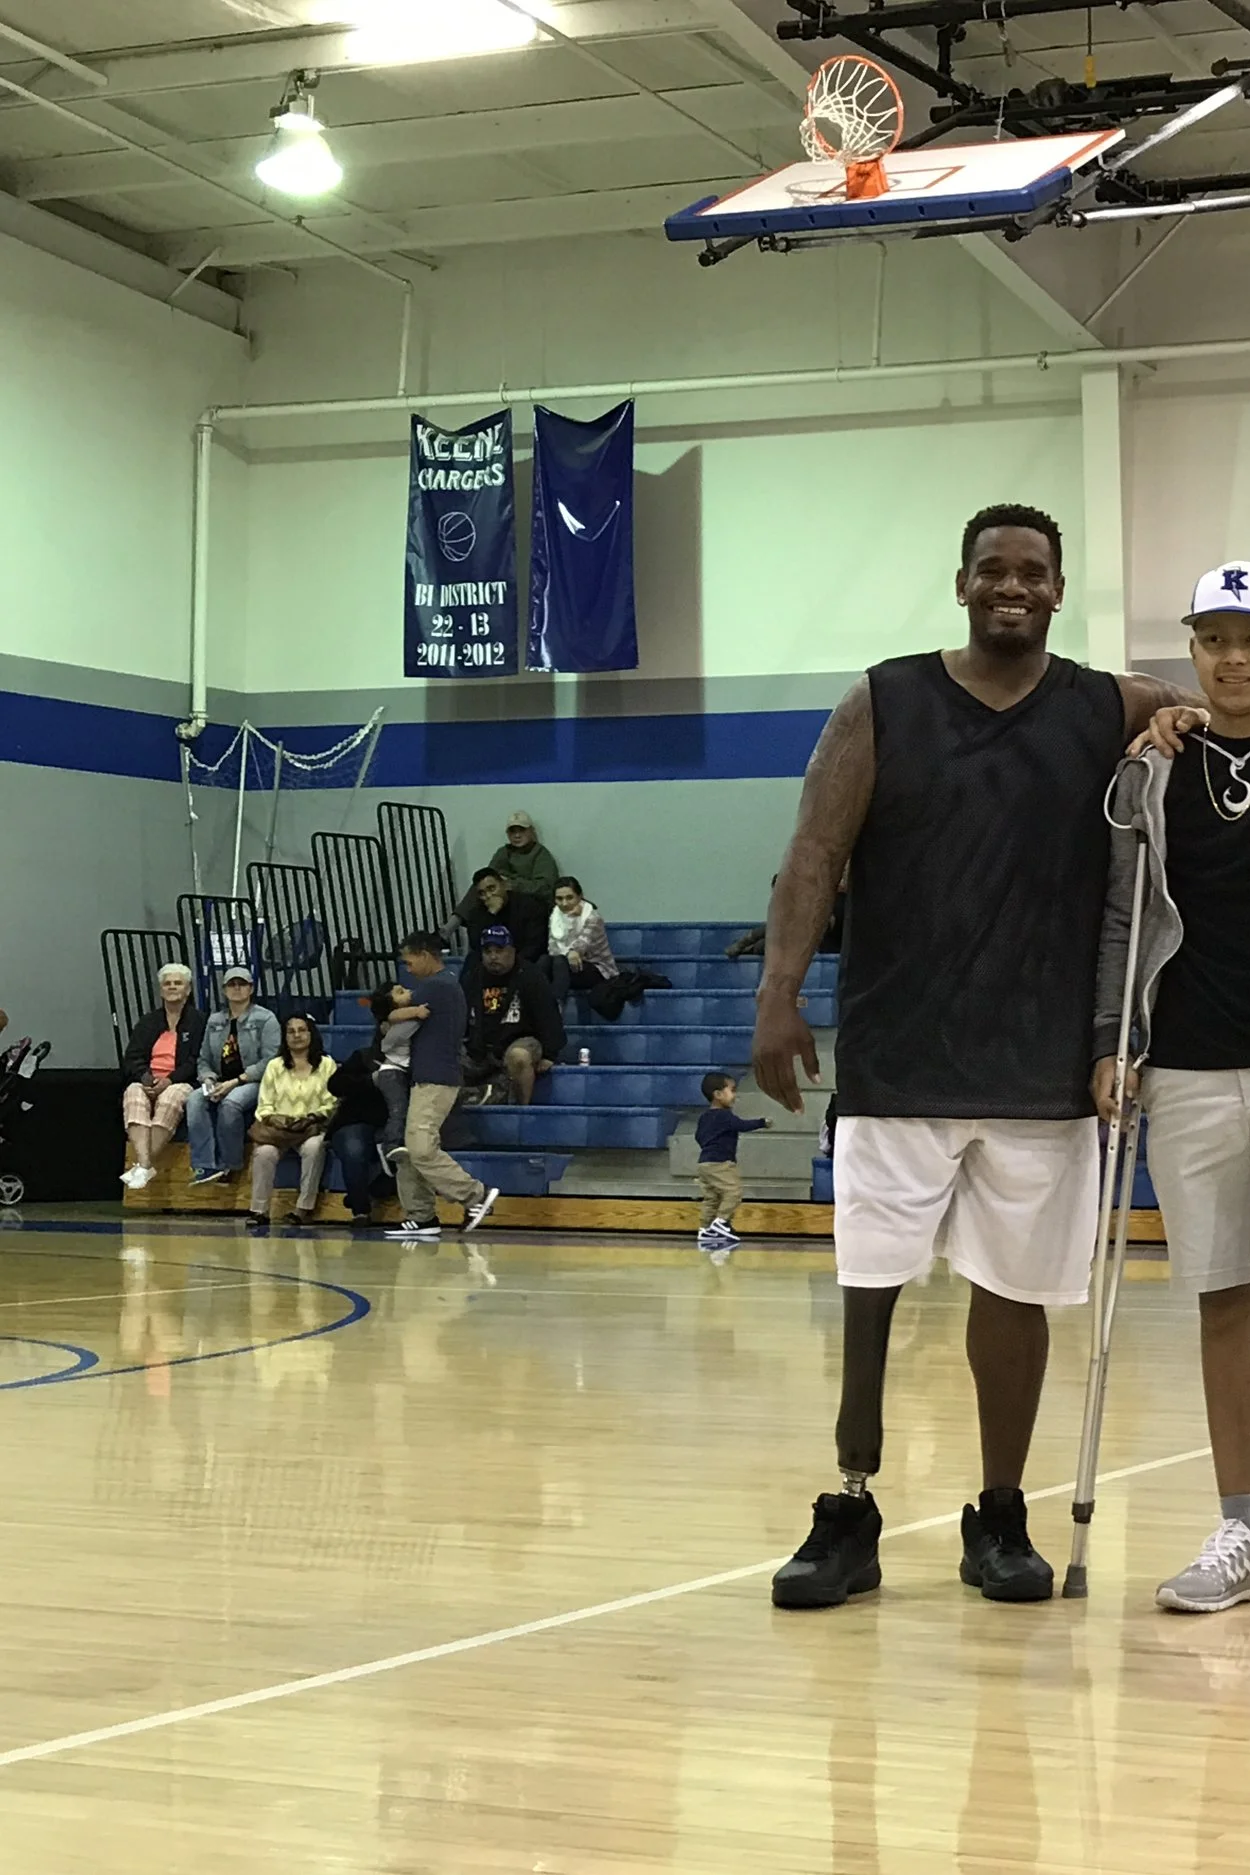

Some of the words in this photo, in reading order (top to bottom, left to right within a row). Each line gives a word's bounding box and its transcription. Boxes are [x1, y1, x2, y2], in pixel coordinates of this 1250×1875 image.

[1221, 568, 1248, 591] K
[415, 583, 434, 607] BI
[440, 581, 507, 607] DISTRICT
[431, 613, 453, 637] 22
[470, 612, 490, 636] 13
[417, 641, 505, 666] 2011-2012
